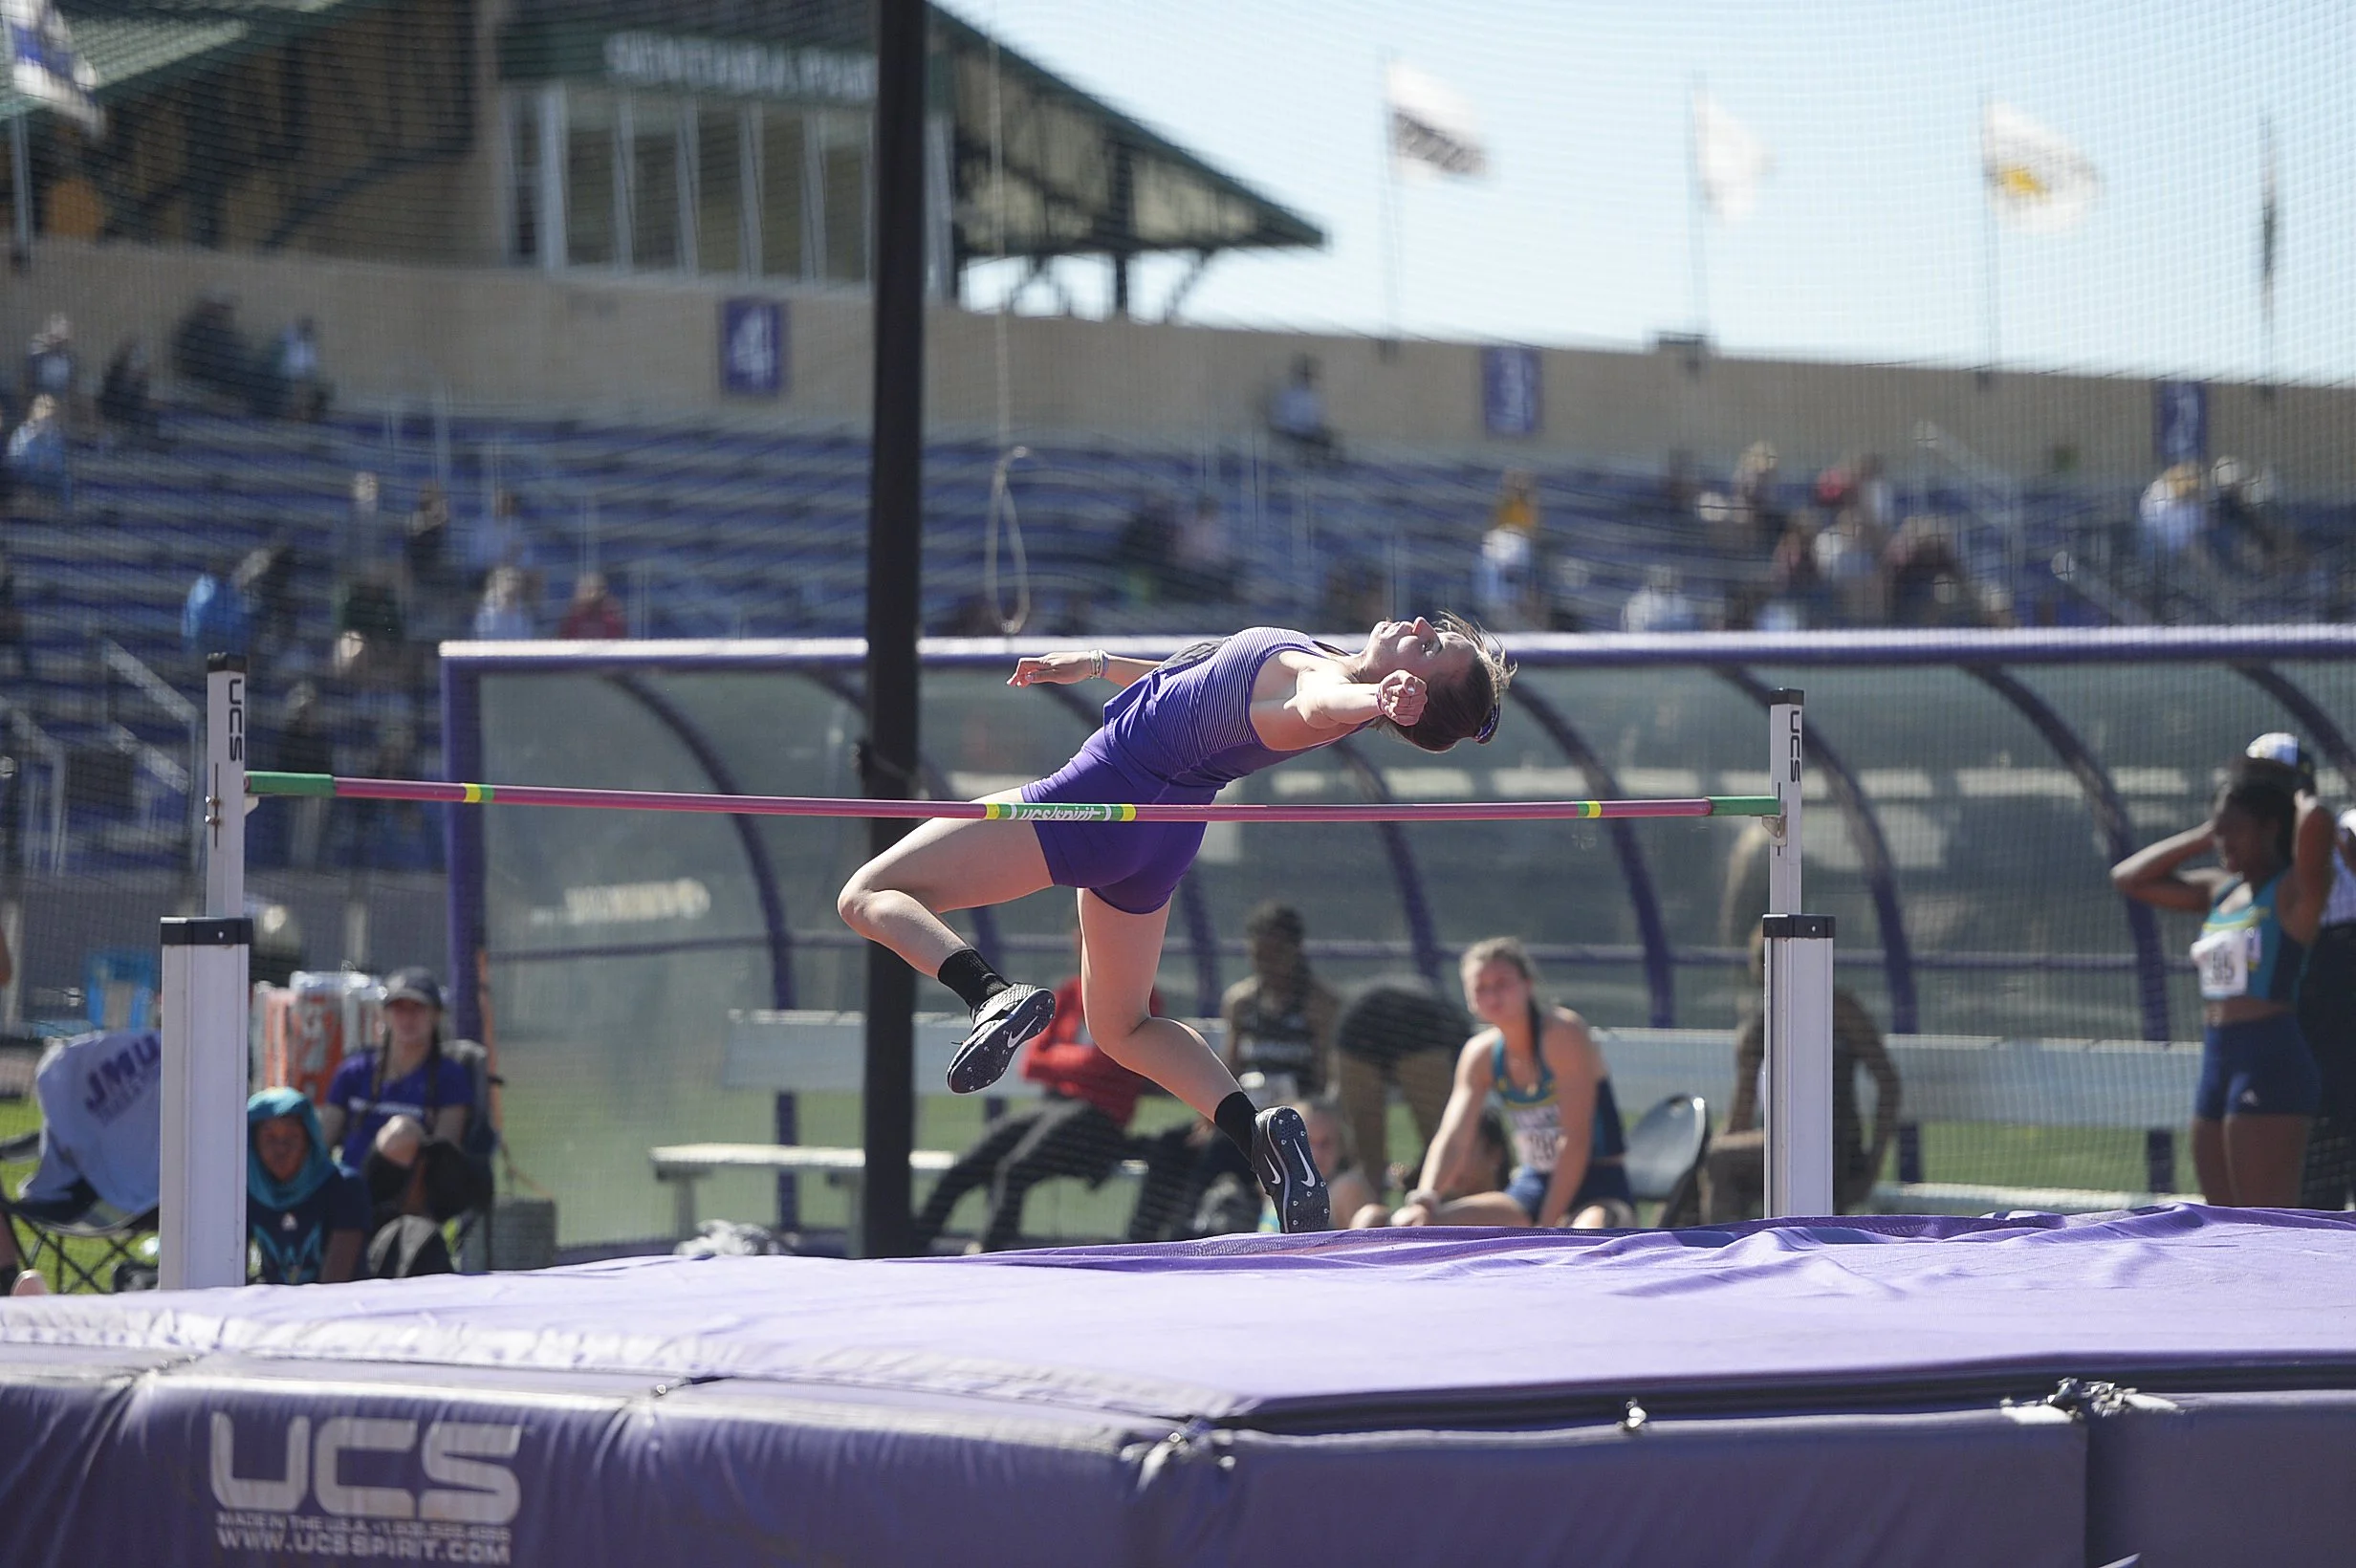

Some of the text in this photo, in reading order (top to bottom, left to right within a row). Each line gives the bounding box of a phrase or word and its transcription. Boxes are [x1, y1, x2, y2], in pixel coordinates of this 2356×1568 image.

[229, 678, 242, 762] UCS
[1790, 710, 1800, 782] UCS
[84, 1034, 161, 1111] JMU
[210, 1411, 522, 1525] UCS
[289, 1514, 322, 1531] THE
